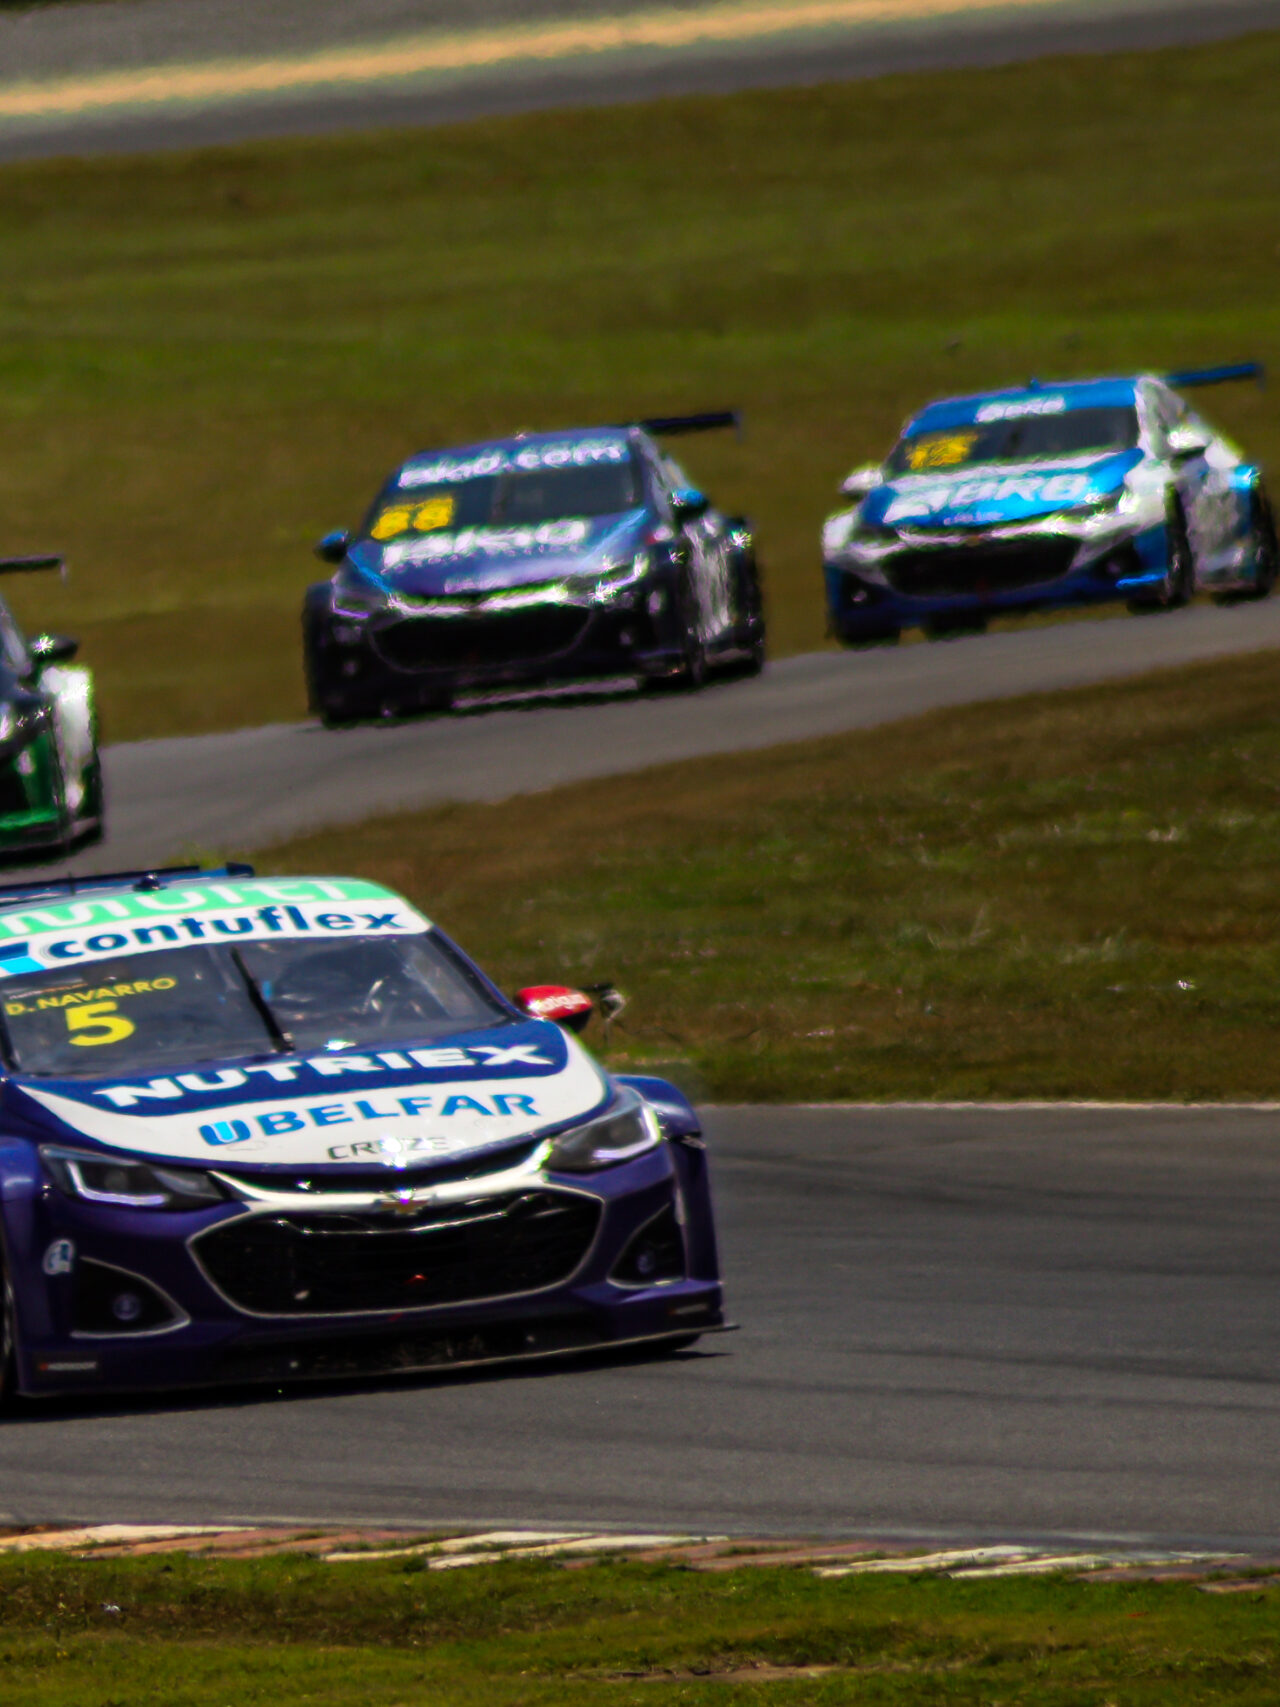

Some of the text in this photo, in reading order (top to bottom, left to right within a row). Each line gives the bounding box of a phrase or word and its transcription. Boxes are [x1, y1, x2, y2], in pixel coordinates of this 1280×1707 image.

[46, 905, 409, 960] contuflex
[65, 1001, 137, 1047] 5
[94, 1045, 556, 1109] NUTRIEX
[326, 1136, 452, 1161] CRZE
